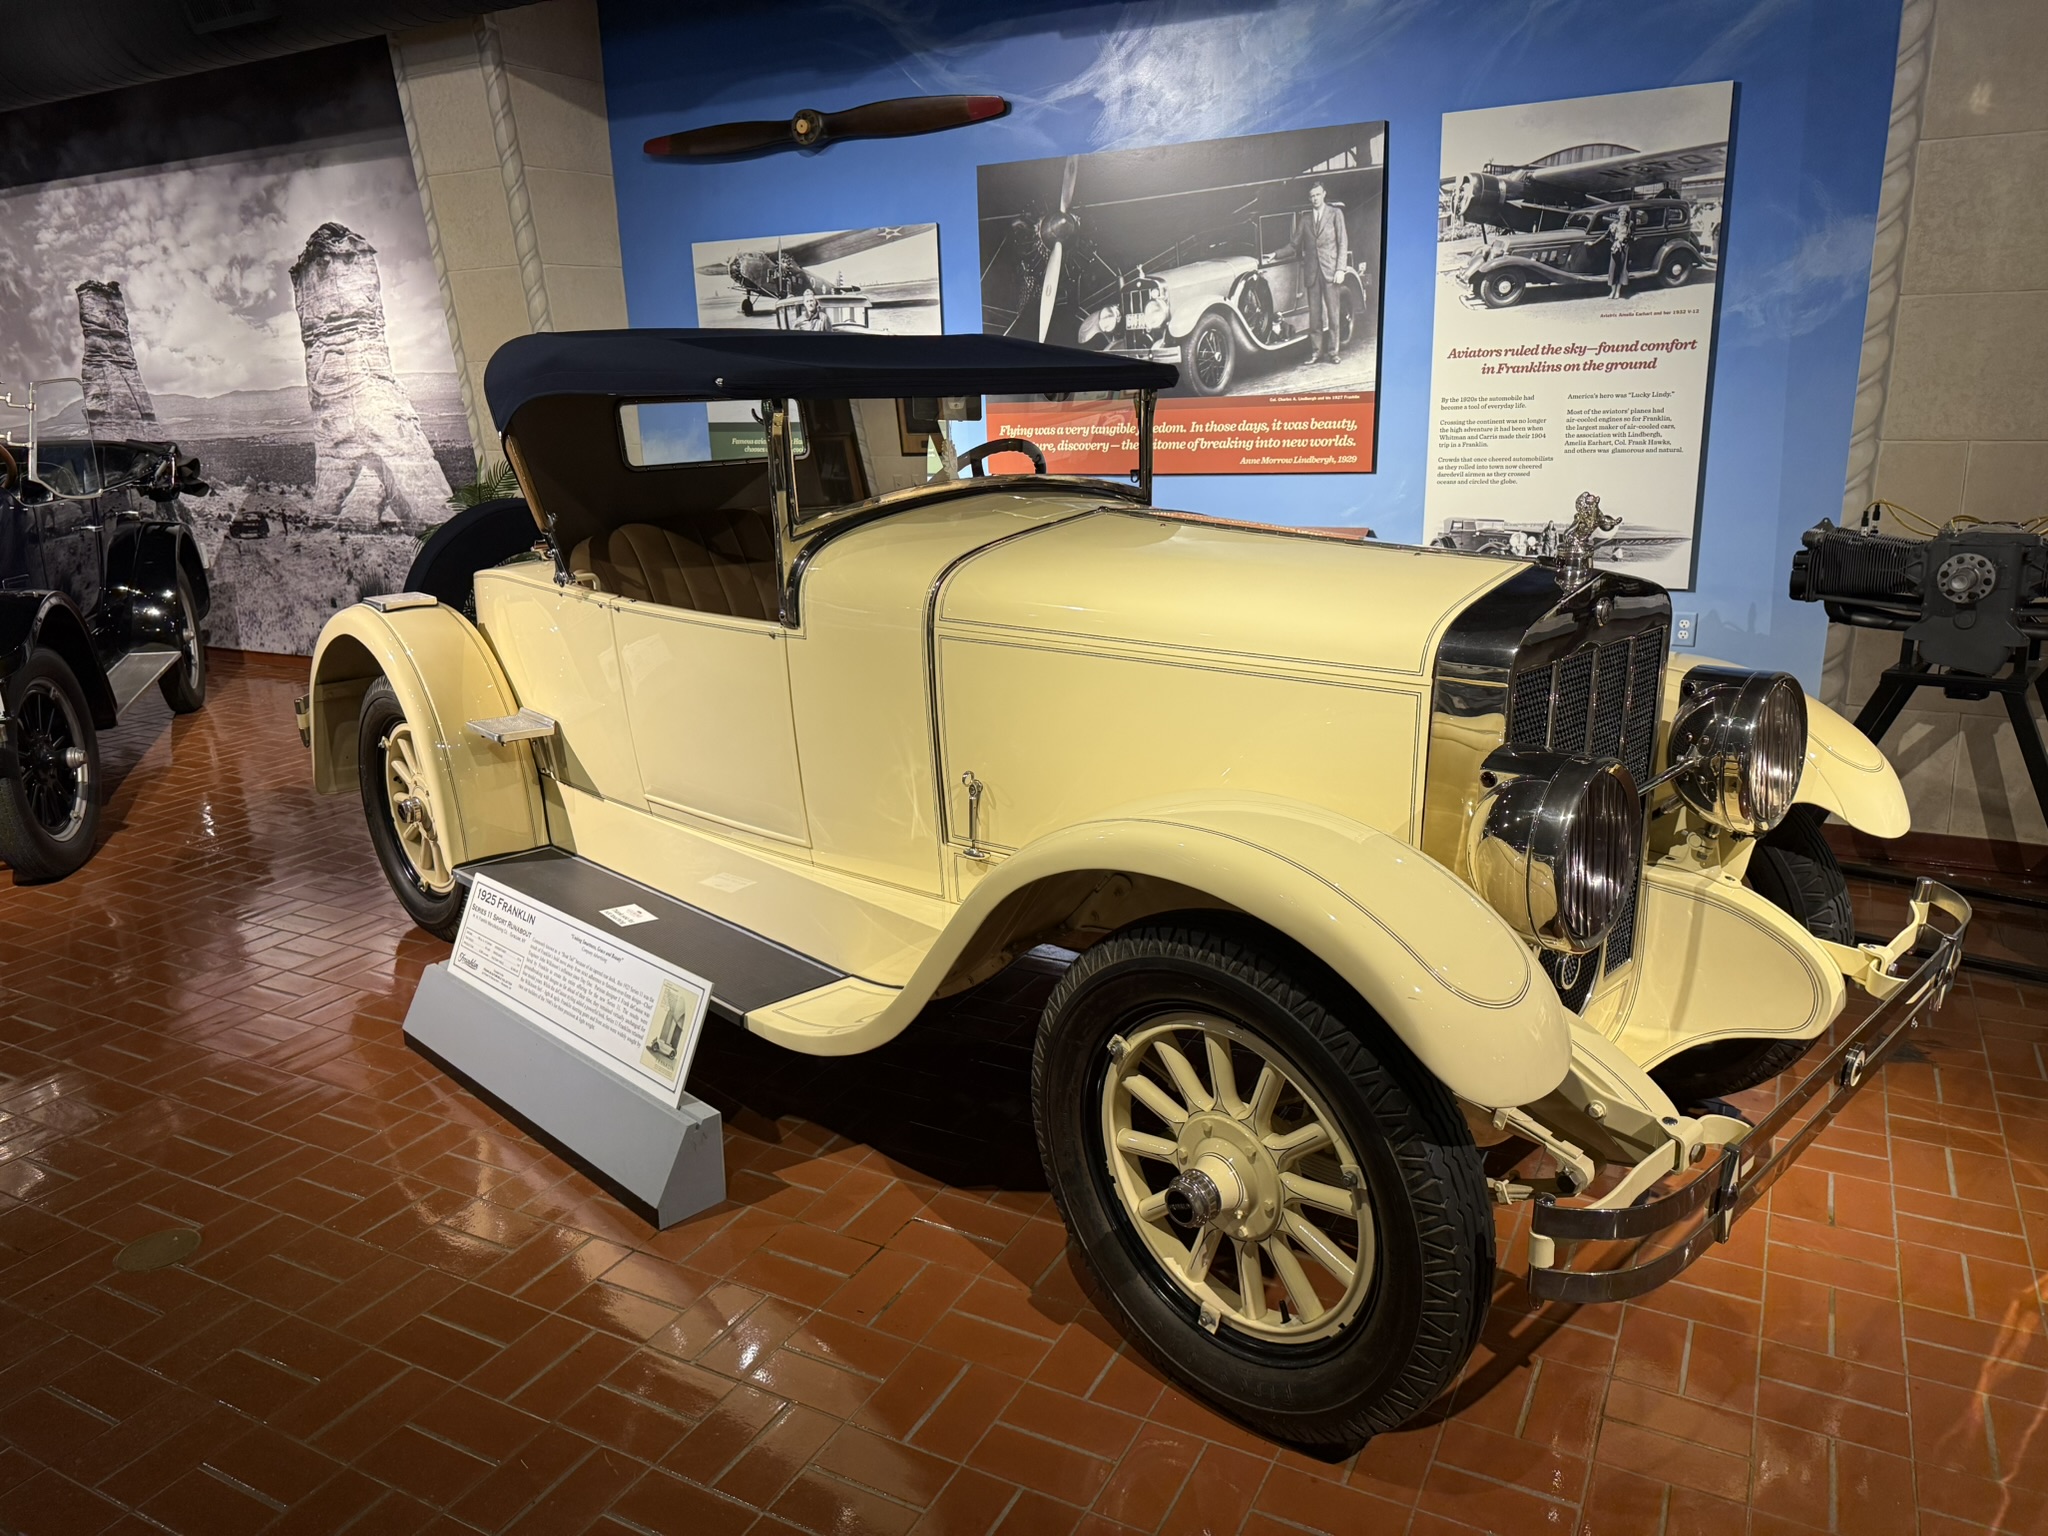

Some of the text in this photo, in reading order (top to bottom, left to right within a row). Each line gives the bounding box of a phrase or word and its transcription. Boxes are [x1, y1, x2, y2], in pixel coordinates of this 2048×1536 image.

[1447, 339, 1698, 359] Aviators ruled the sky—found comfort
[1482, 357, 1658, 375] in Franklins on the ground
[999, 425, 1034, 439] Flying
[1035, 427, 1056, 435] was
[1057, 427, 1064, 435] a
[1065, 427, 1090, 437] very
[1091, 423, 1136, 436] tangible
[1190, 422, 1204, 433] In
[1205, 421, 1237, 432] those
[1238, 420, 1270, 434] days,
[1272, 419, 1283, 431] it
[1283, 421, 1309, 430] was
[1310, 418, 1358, 431] beauty,
[1058, 440, 1109, 452] discovery
[1122, 439, 1139, 450] the
[1187, 438, 1200, 451] of
[1200, 437, 1254, 451] breaking
[1255, 437, 1281, 448] into
[1282, 439, 1309, 448] new
[1310, 435, 1356, 447] worlds.
[1240, 457, 1261, 465] Anne
[1293, 456, 1337, 465] Lindbergh,
[477, 888, 537, 926] 1925 FRANKLIN
[472, 903, 487, 916] SERIES
[493, 913, 508, 926] SPORT
[507, 920, 532, 939] RUNABOUT
